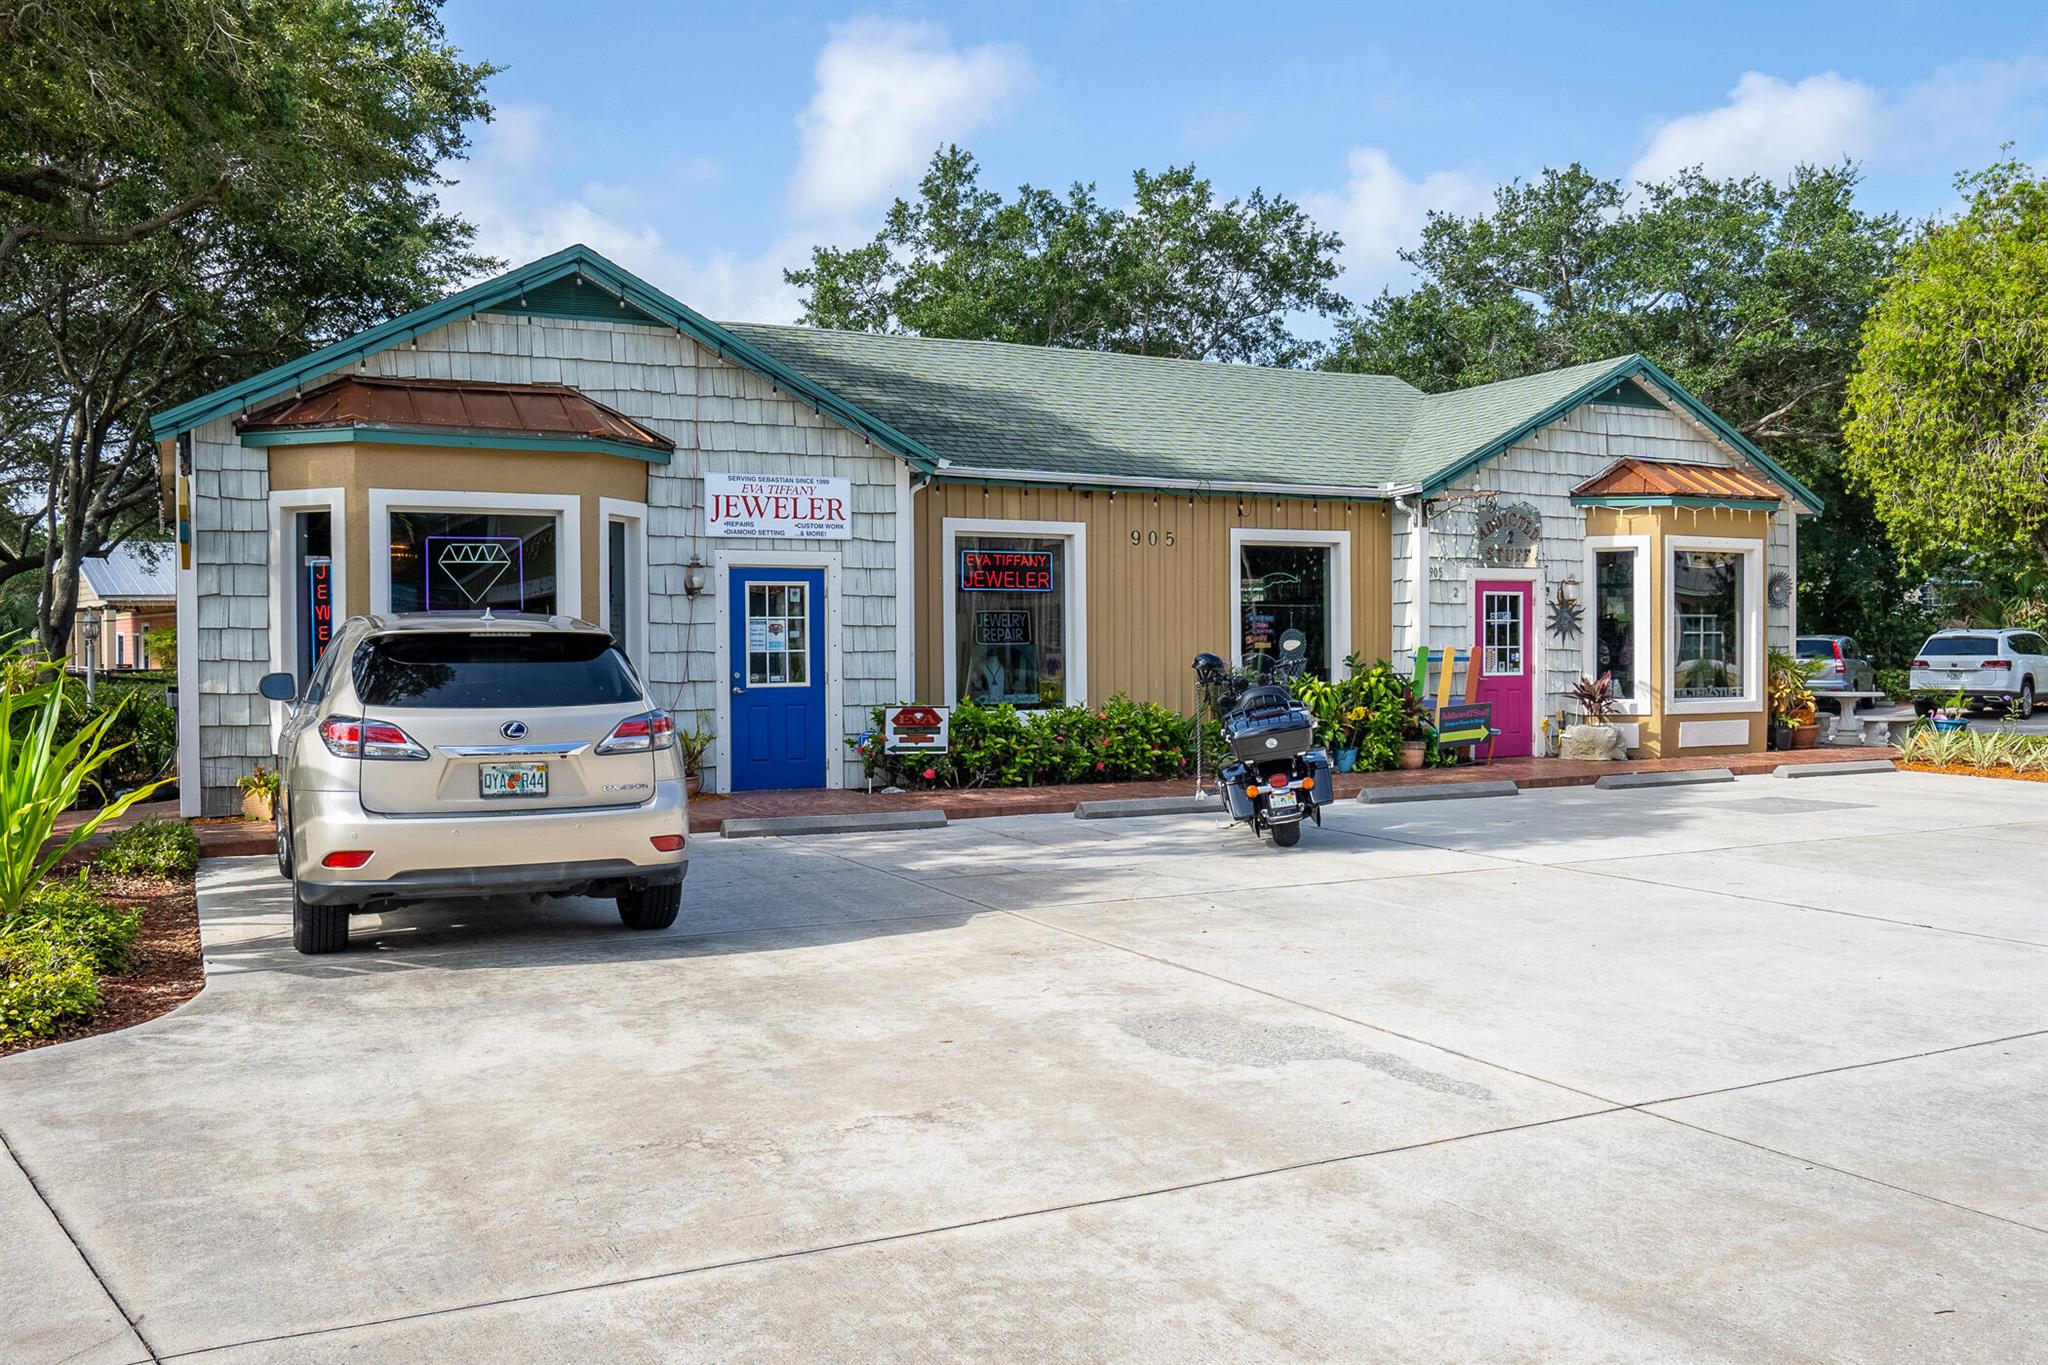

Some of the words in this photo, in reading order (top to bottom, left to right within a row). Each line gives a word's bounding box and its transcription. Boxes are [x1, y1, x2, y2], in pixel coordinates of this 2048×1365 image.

[727, 475, 757, 483] SERVING
[758, 476, 795, 484] SEBASTIAN
[741, 484, 764, 494] EVA
[768, 484, 817, 496] TIFFANY
[710, 494, 847, 523] JEWELER
[1480, 512, 1540, 541] ADDICTED
[1131, 530, 1175, 546] 905
[1506, 529, 1514, 545] 2
[966, 554, 992, 566] EVA
[993, 554, 1047, 567] TIFFANY
[1486, 547, 1532, 562] STUFF
[964, 570, 1050, 588] JEWELER
[1429, 566, 1443, 578] 905
[1453, 586, 1459, 597] 2
[977, 613, 1026, 627] JEWELRY
[983, 628, 1024, 642] REPAIR
[900, 714, 936, 724] EVA
[521, 772, 544, 788] R44
